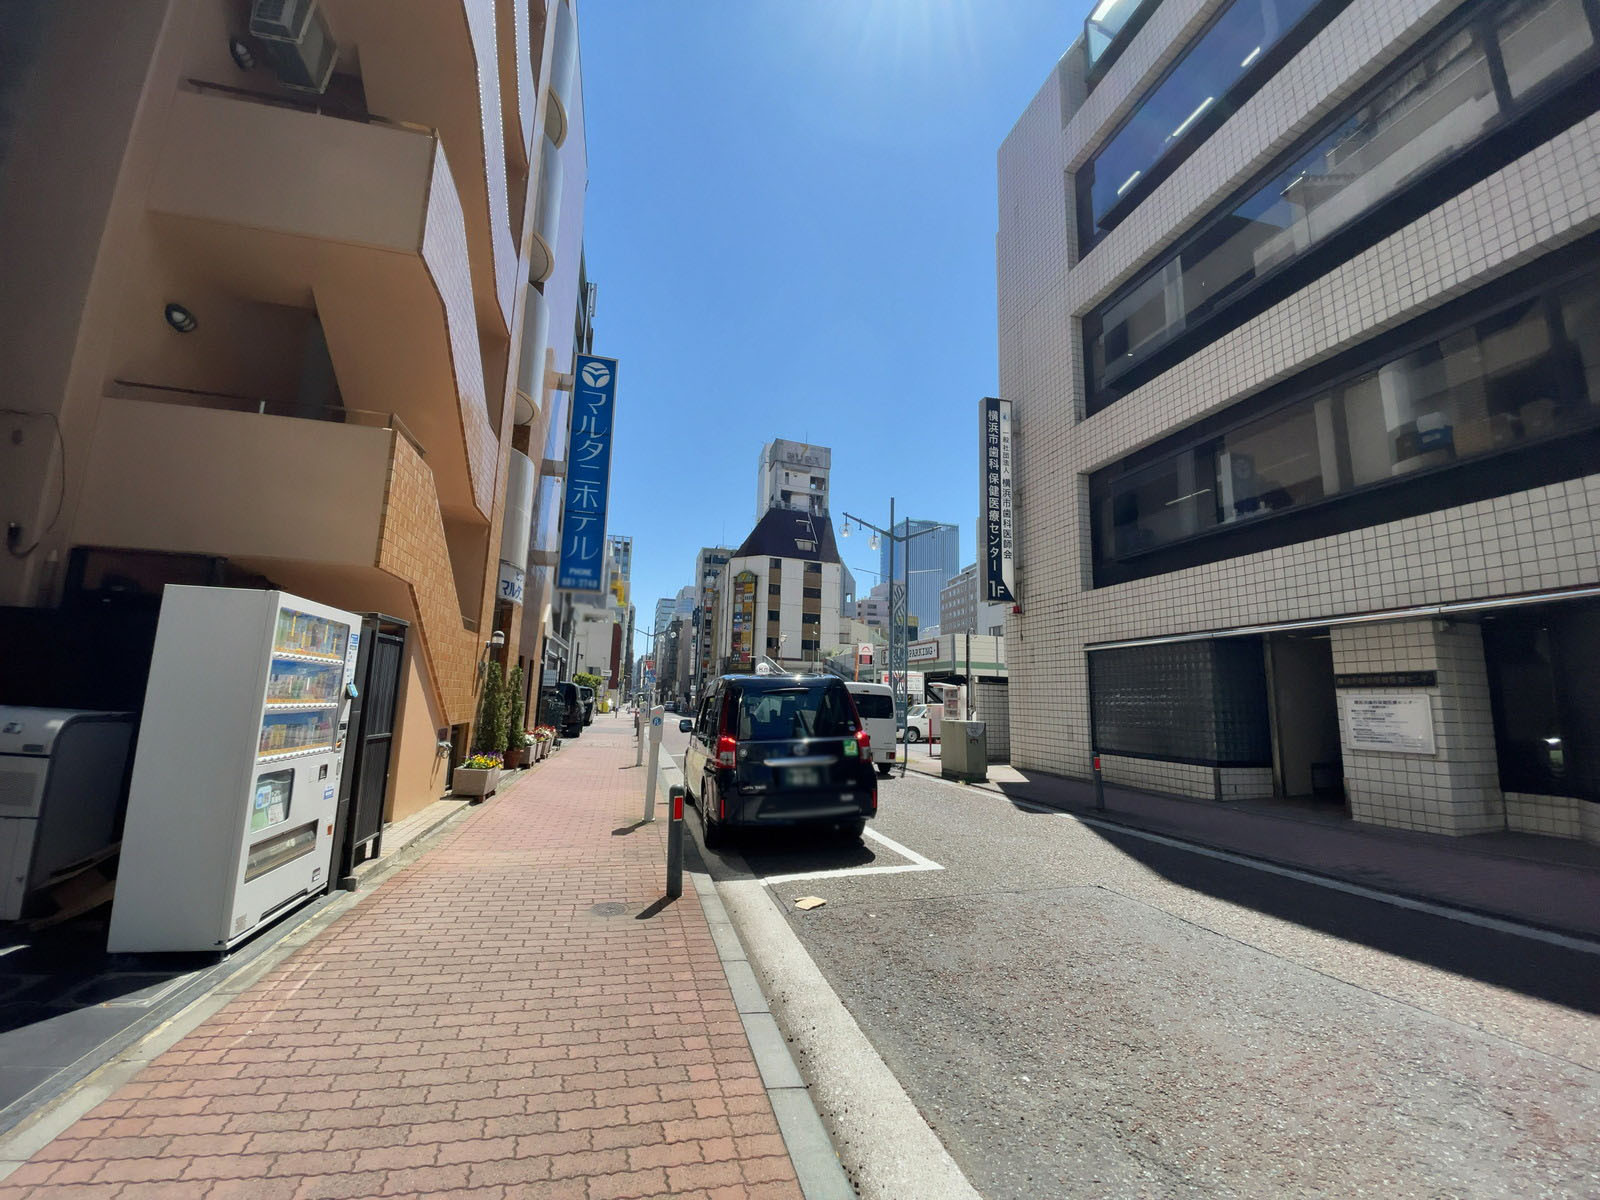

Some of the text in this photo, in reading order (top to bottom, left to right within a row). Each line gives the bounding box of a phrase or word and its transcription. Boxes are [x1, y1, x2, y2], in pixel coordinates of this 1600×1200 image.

[566, 390, 607, 561] マルタニホテル
[988, 410, 999, 571] 横浜市歯科保健医療センター
[1002, 431, 1012, 560] 一般社団法人 横浜市歯科医師会
[989, 580, 1004, 597] 1F
